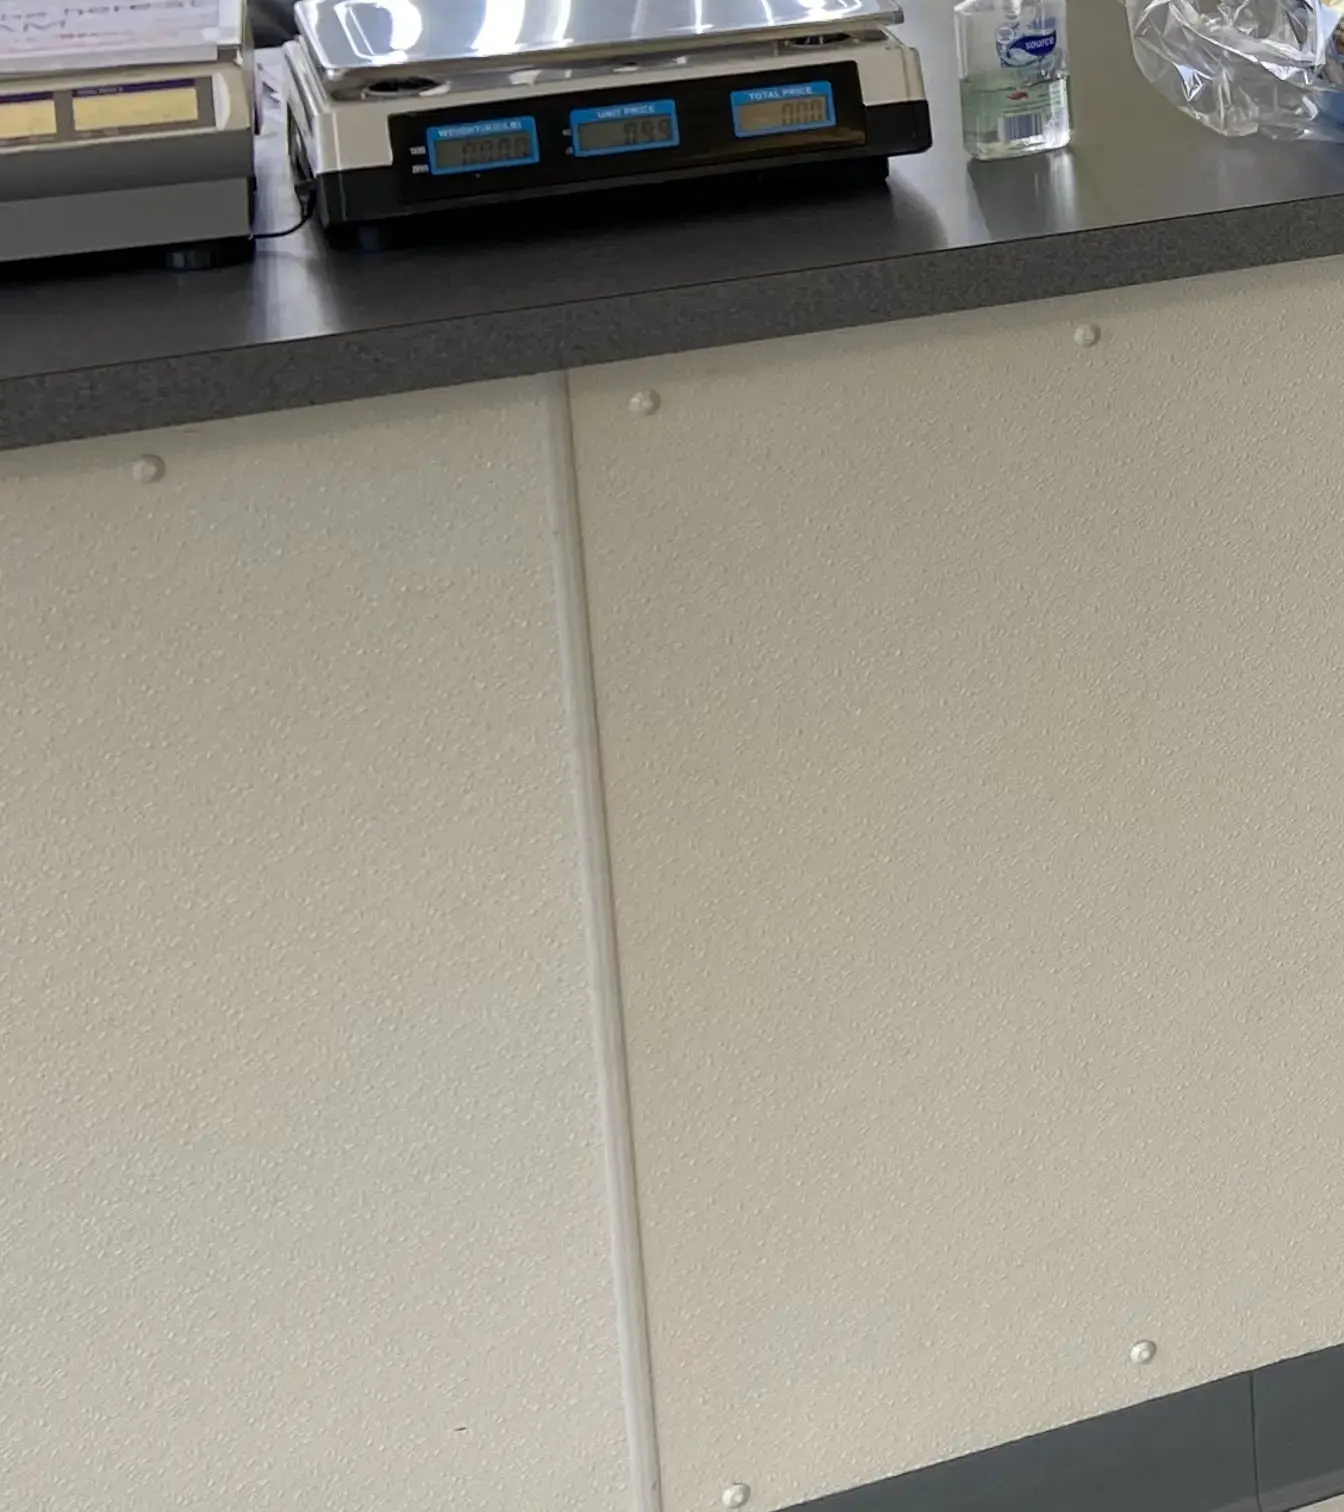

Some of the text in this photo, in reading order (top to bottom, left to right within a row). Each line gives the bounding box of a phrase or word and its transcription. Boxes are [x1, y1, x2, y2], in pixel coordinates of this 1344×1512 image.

[745, 86, 814, 100] TOTAL PRICE
[624, 104, 655, 116] PRICE
